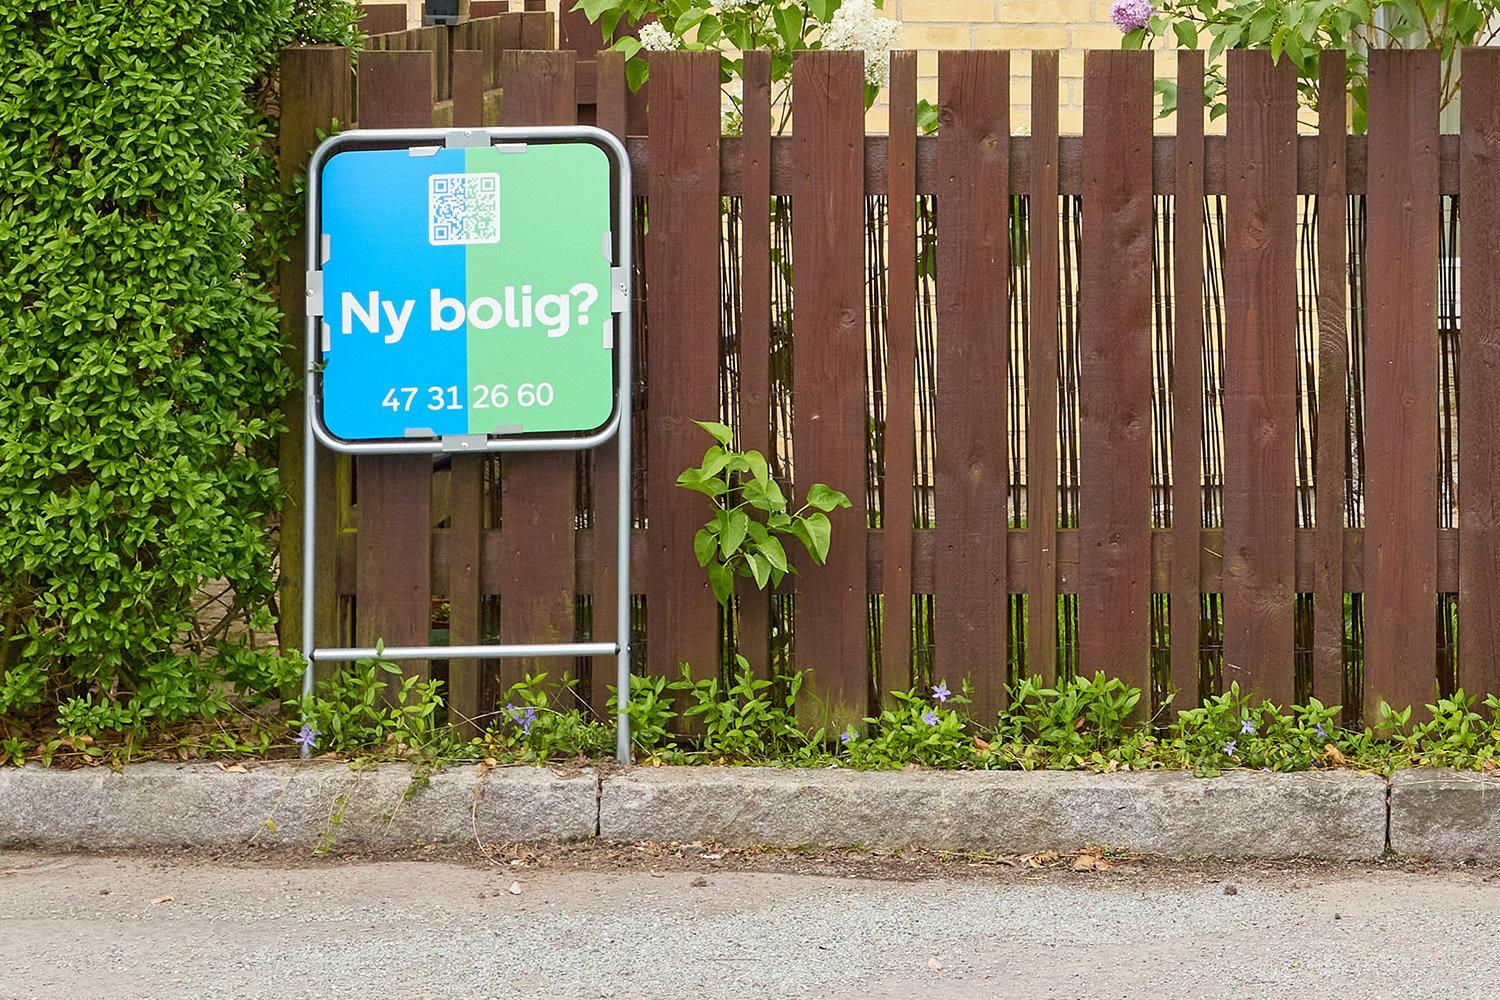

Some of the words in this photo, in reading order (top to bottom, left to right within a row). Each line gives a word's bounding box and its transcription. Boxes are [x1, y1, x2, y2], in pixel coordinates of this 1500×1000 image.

[341, 290, 416, 344] Ny
[430, 282, 599, 338] bolig?
[382, 387, 418, 412] 47
[427, 385, 463, 410] 31
[472, 383, 509, 409] 26
[517, 382, 554, 407] 60
